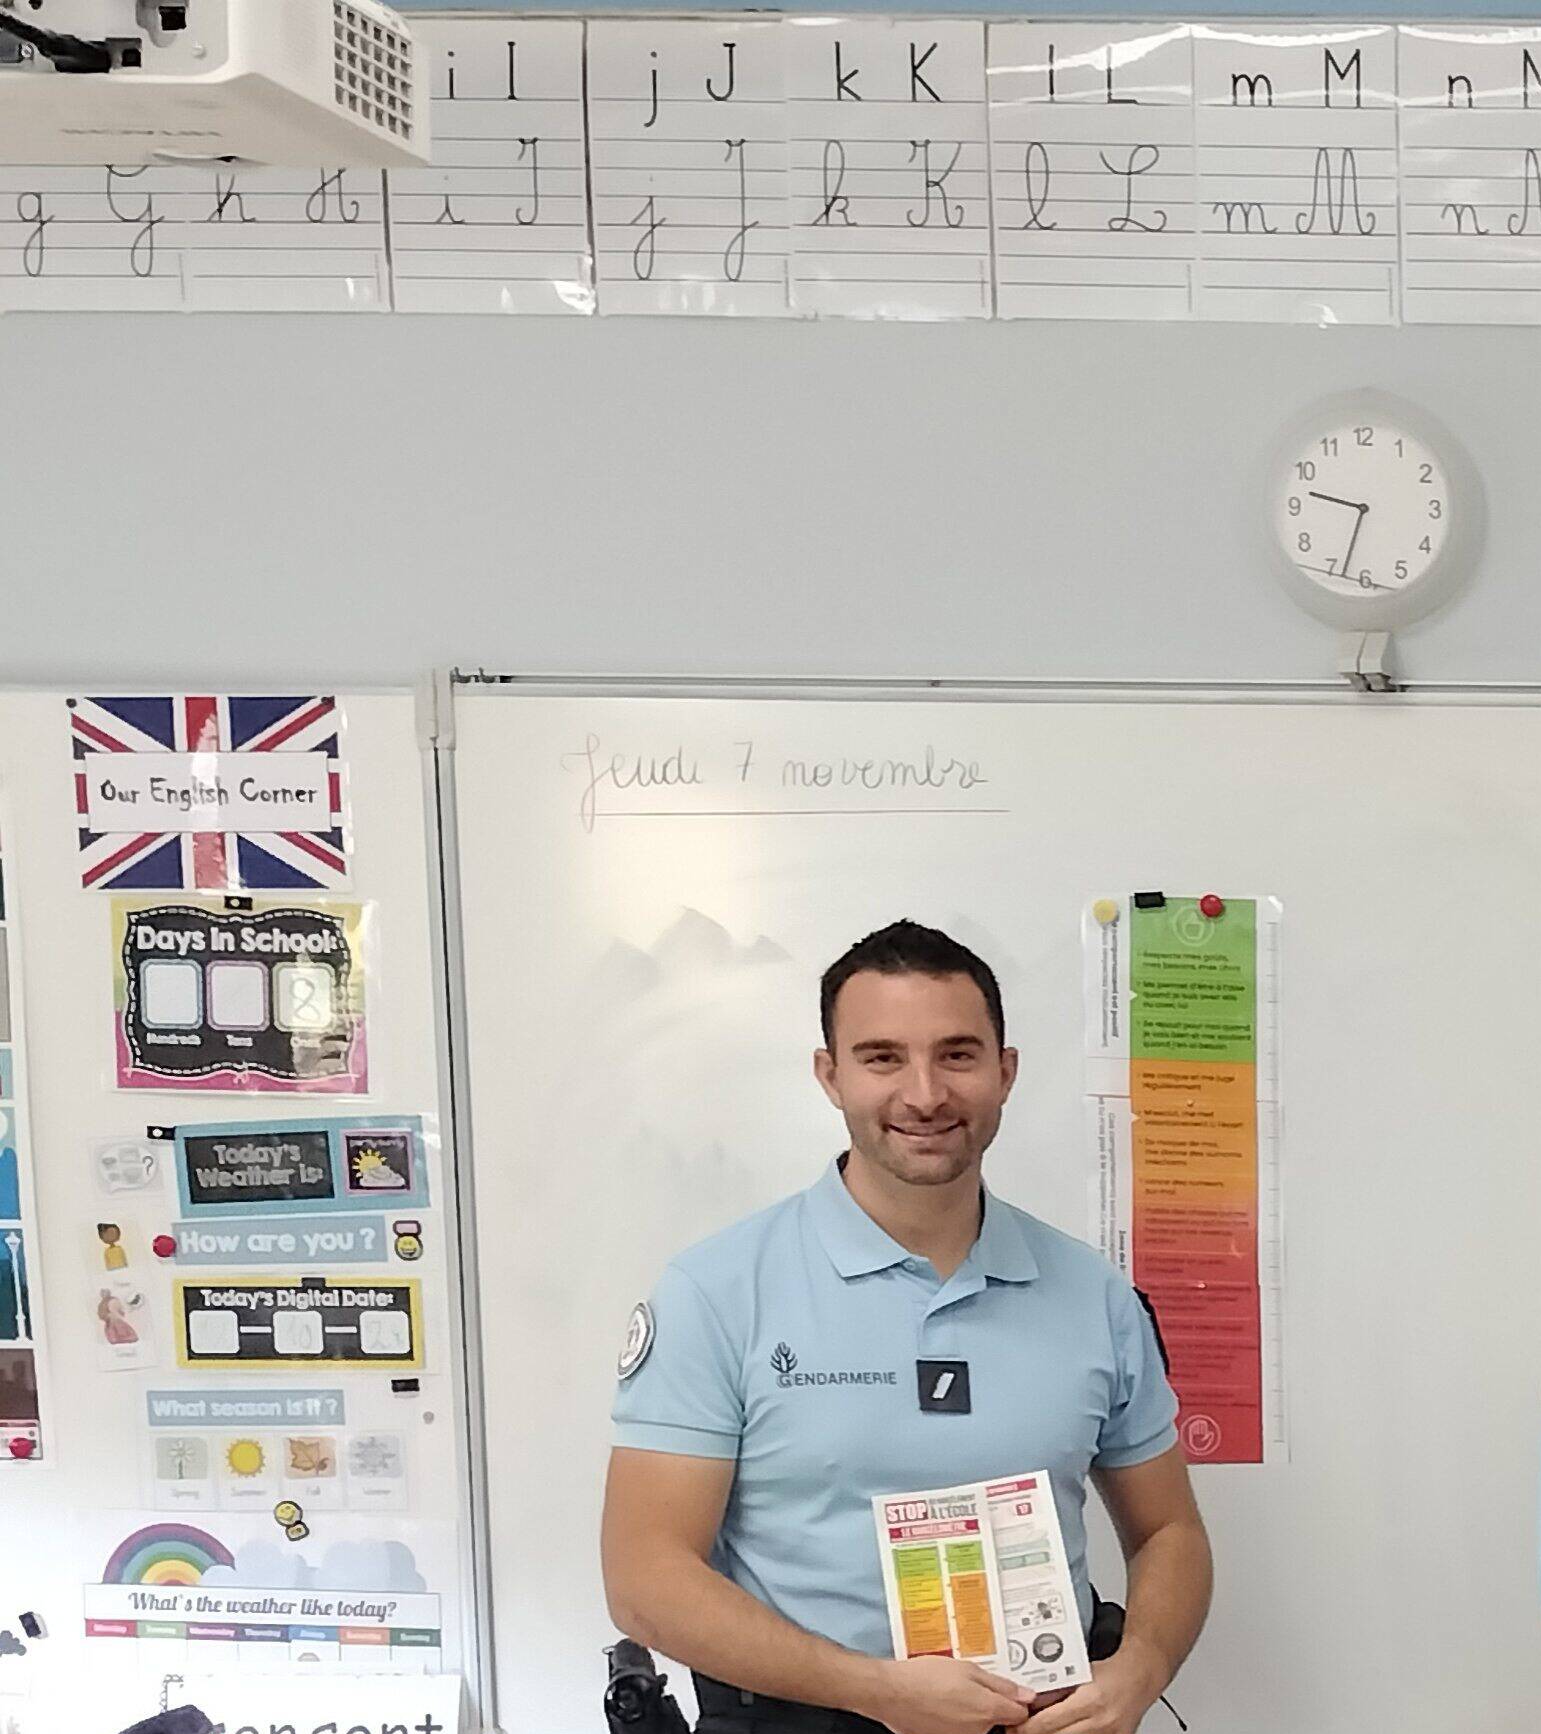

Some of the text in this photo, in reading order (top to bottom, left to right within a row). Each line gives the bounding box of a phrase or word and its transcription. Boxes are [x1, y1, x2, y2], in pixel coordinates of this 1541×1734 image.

[1353, 427, 1373, 446] 12
[1320, 438, 1338, 456] 11
[1394, 439, 1402, 458] 1
[1296, 462, 1315, 480] 10
[1419, 463, 1432, 483] 2
[1288, 497, 1301, 516] 9
[1428, 500, 1441, 519] 3
[1298, 532, 1311, 551] 8
[1419, 535, 1431, 553] 4
[1325, 558, 1338, 576] 7
[1395, 560, 1407, 579] 5
[1359, 570, 1371, 588] 6
[734, 741, 753, 782] 7
[782, 745, 988, 789] novembre
[100, 777, 317, 811] Our English Corner
[137, 927, 338, 955] Days In School:
[213, 1143, 301, 1165] Today's
[197, 1166, 292, 1190] Weather
[181, 1231, 353, 1256] How are you
[200, 1289, 393, 1309] Today's Digital Date:
[777, 1370, 897, 1389] GENDARMERIE
[152, 1398, 207, 1417] What
[212, 1401, 281, 1417] season
[886, 1501, 928, 1523] STOP
[196, 1595, 222, 1613] the
[227, 1597, 297, 1615] weather
[301, 1599, 332, 1616] like
[337, 1600, 396, 1622] today?
